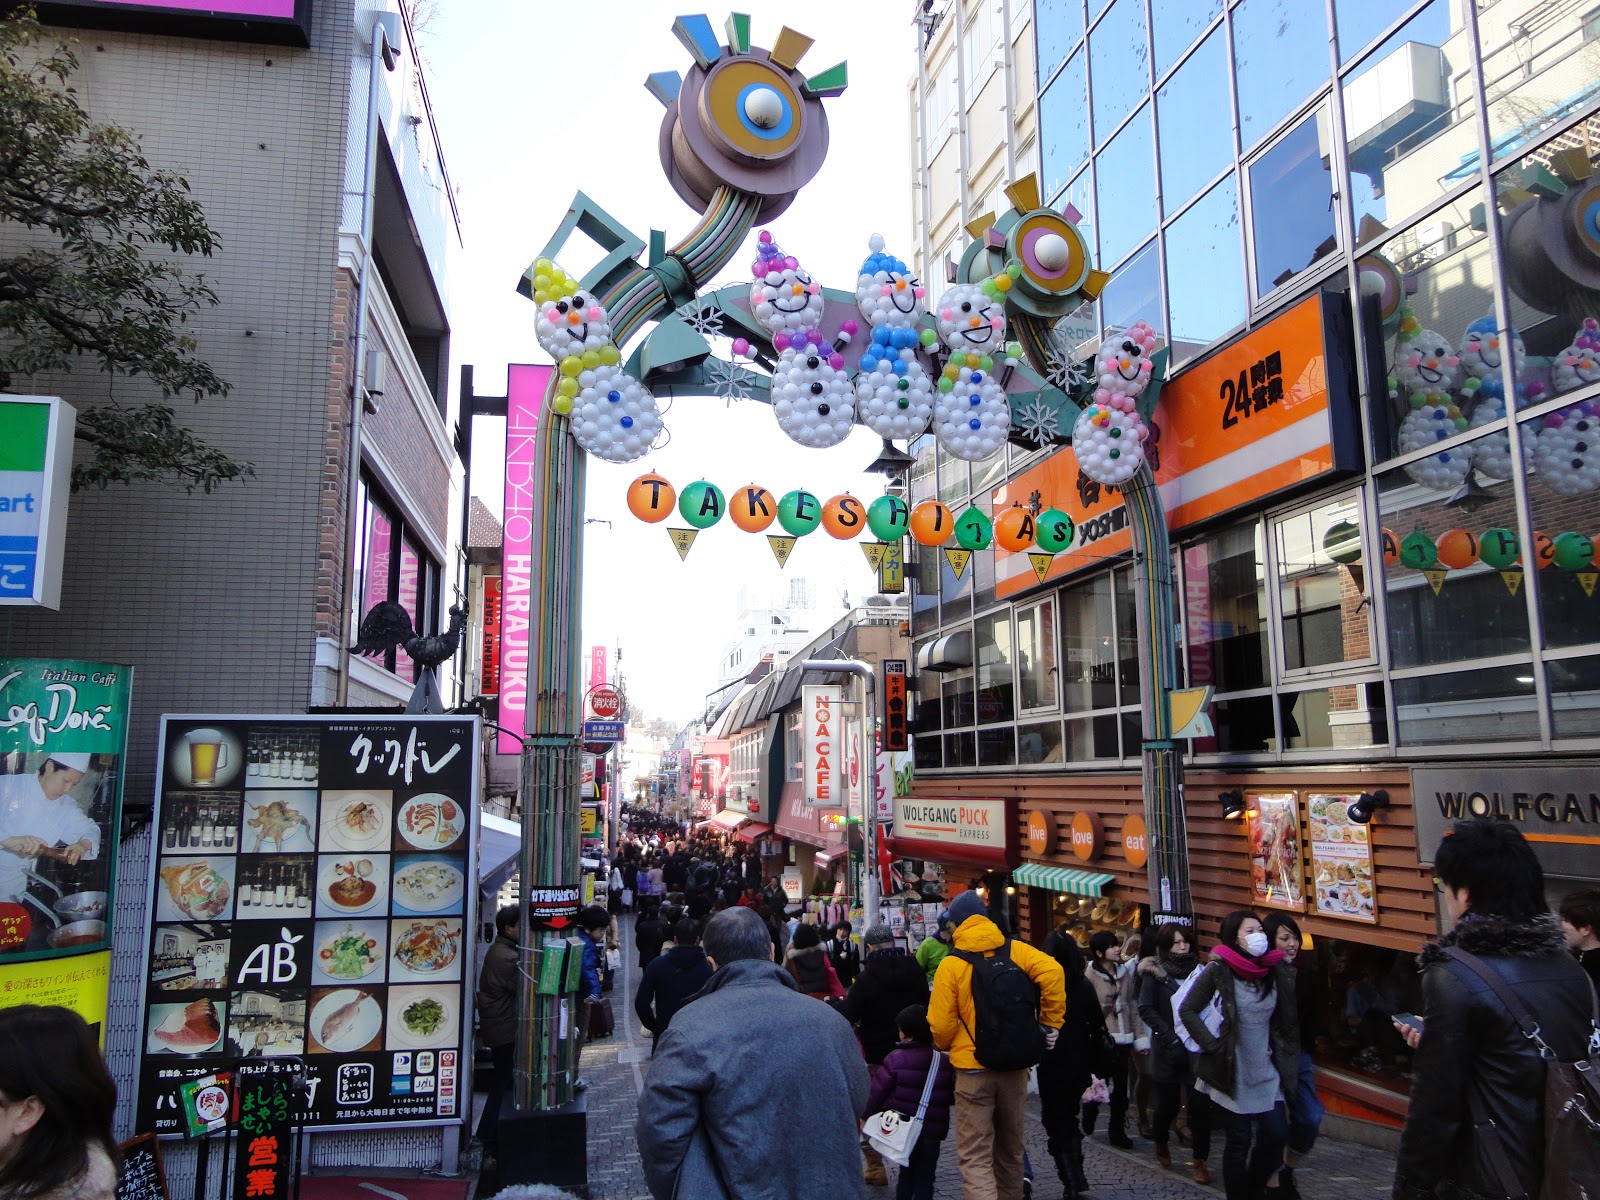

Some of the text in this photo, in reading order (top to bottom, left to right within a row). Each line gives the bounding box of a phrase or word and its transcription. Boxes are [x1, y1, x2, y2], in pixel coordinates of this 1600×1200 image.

[1220, 369, 1252, 430] 24
[1078, 504, 1131, 547] YOSHIN
[484, 597, 494, 689] INTERNET CAFE
[502, 555, 532, 711] HARAJUKU
[40, 669, 87, 683] Italian
[593, 696, 618, 709] 消火栓
[815, 695, 831, 800] NOA CAFE
[902, 804, 989, 827] WOLFGANG PUCK
[960, 828, 990, 840] EXPRESS
[1030, 823, 1045, 841] live
[1072, 828, 1092, 845] love
[1126, 833, 1145, 850] eat
[237, 941, 298, 984] AB
[415, 1078, 434, 1090] JAL
[245, 1135, 278, 1197] 営業
